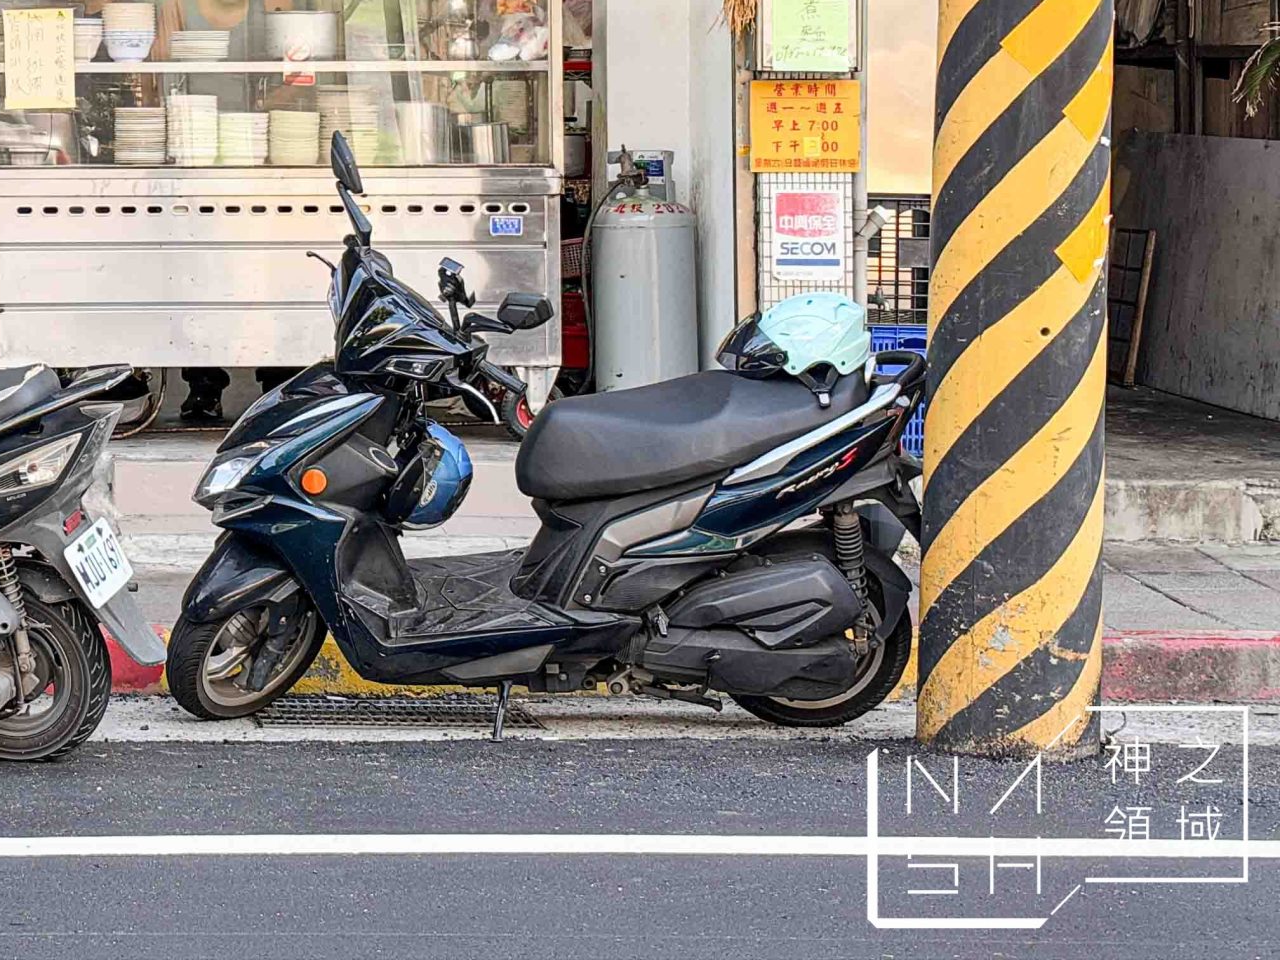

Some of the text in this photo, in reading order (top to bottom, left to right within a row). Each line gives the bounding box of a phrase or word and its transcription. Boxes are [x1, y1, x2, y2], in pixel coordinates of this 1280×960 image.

[773, 82, 837, 97] 營業時間
[780, 241, 836, 256] SECOM
